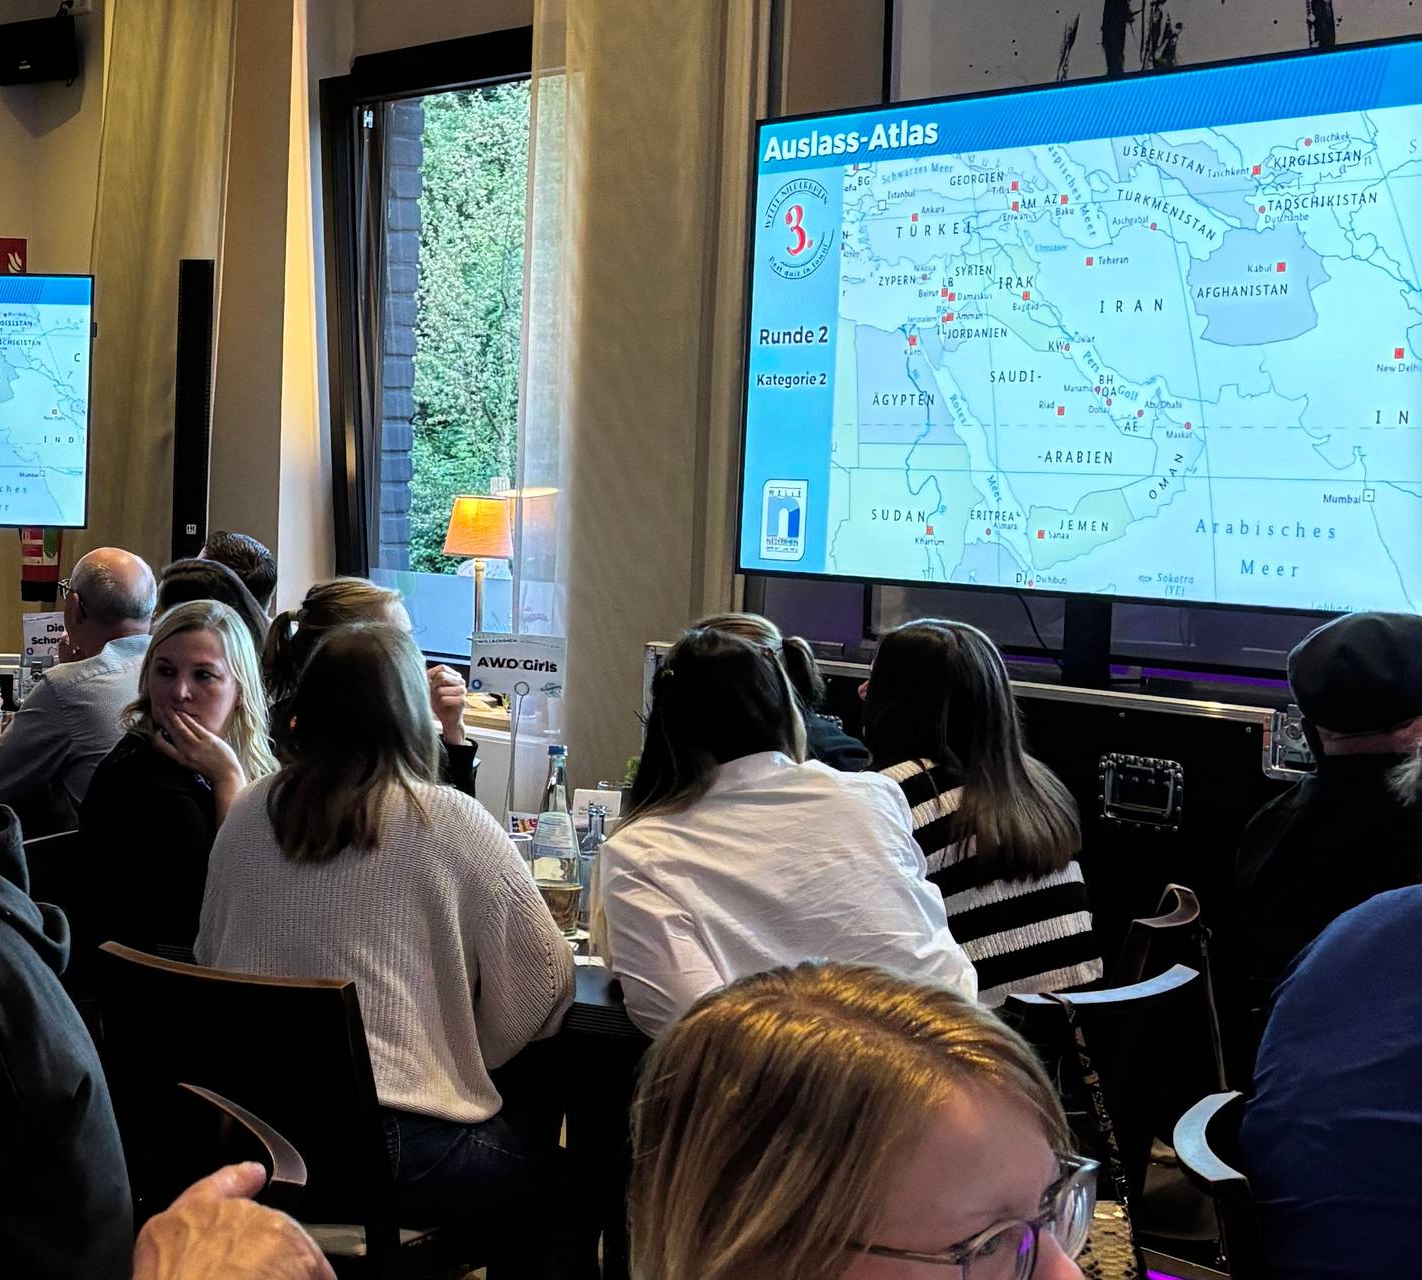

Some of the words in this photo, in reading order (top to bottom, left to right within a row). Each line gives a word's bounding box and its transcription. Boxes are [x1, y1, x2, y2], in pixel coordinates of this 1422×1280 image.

[763, 120, 939, 162] Auslass-Atlas
[1122, 145, 1206, 176] USBEKISTAN
[1274, 150, 1362, 169] KIRGISISTAN
[950, 172, 1005, 186] GEORGIEN
[1207, 166, 1250, 179] Taschkent
[858, 176, 871, 186] BG
[1044, 194, 1058, 204] AZ
[1268, 192, 1378, 211] TADSCHIKISTAN
[1056, 207, 1075, 217] Baku
[1116, 189, 1217, 241] TURKMENISTAN
[785, 204, 814, 256] 3.
[896, 221, 971, 239] TÜRKEI
[1098, 255, 1129, 265] Teheran
[955, 265, 993, 277] SYRIEN
[1247, 263, 1273, 273] Kabul
[878, 275, 916, 286] ZYPERN
[998, 276, 1034, 290] IRAK
[1197, 284, 1288, 299] AFGHANISTAN
[1100, 298, 1164, 314] IRAN
[759, 327, 815, 345] Runde
[818, 326, 828, 343] 2
[948, 327, 1008, 339] JORDANIEN
[1376, 363, 1396, 373] New
[756, 372, 816, 391] Kategorie
[819, 373, 827, 386] 2
[989, 370, 1042, 383] SAUDI-
[1099, 375, 1114, 385] BH
[872, 391, 936, 406] ÄGYPTEN
[1038, 401, 1055, 410] Riad
[1124, 421, 1138, 432] AE
[1037, 450, 1113, 465] -ARABIEN
[1148, 453, 1184, 501] OMAN
[1323, 493, 1361, 504] Mumbai
[871, 509, 926, 523] SUDAN
[970, 509, 1015, 522] ERITREA
[1059, 519, 1110, 532] JEMEN
[1195, 518, 1337, 539] Arabisches
[1240, 560, 1299, 577] Meer
[477, 656, 518, 669] AWO
[523, 659, 558, 673] Girls
